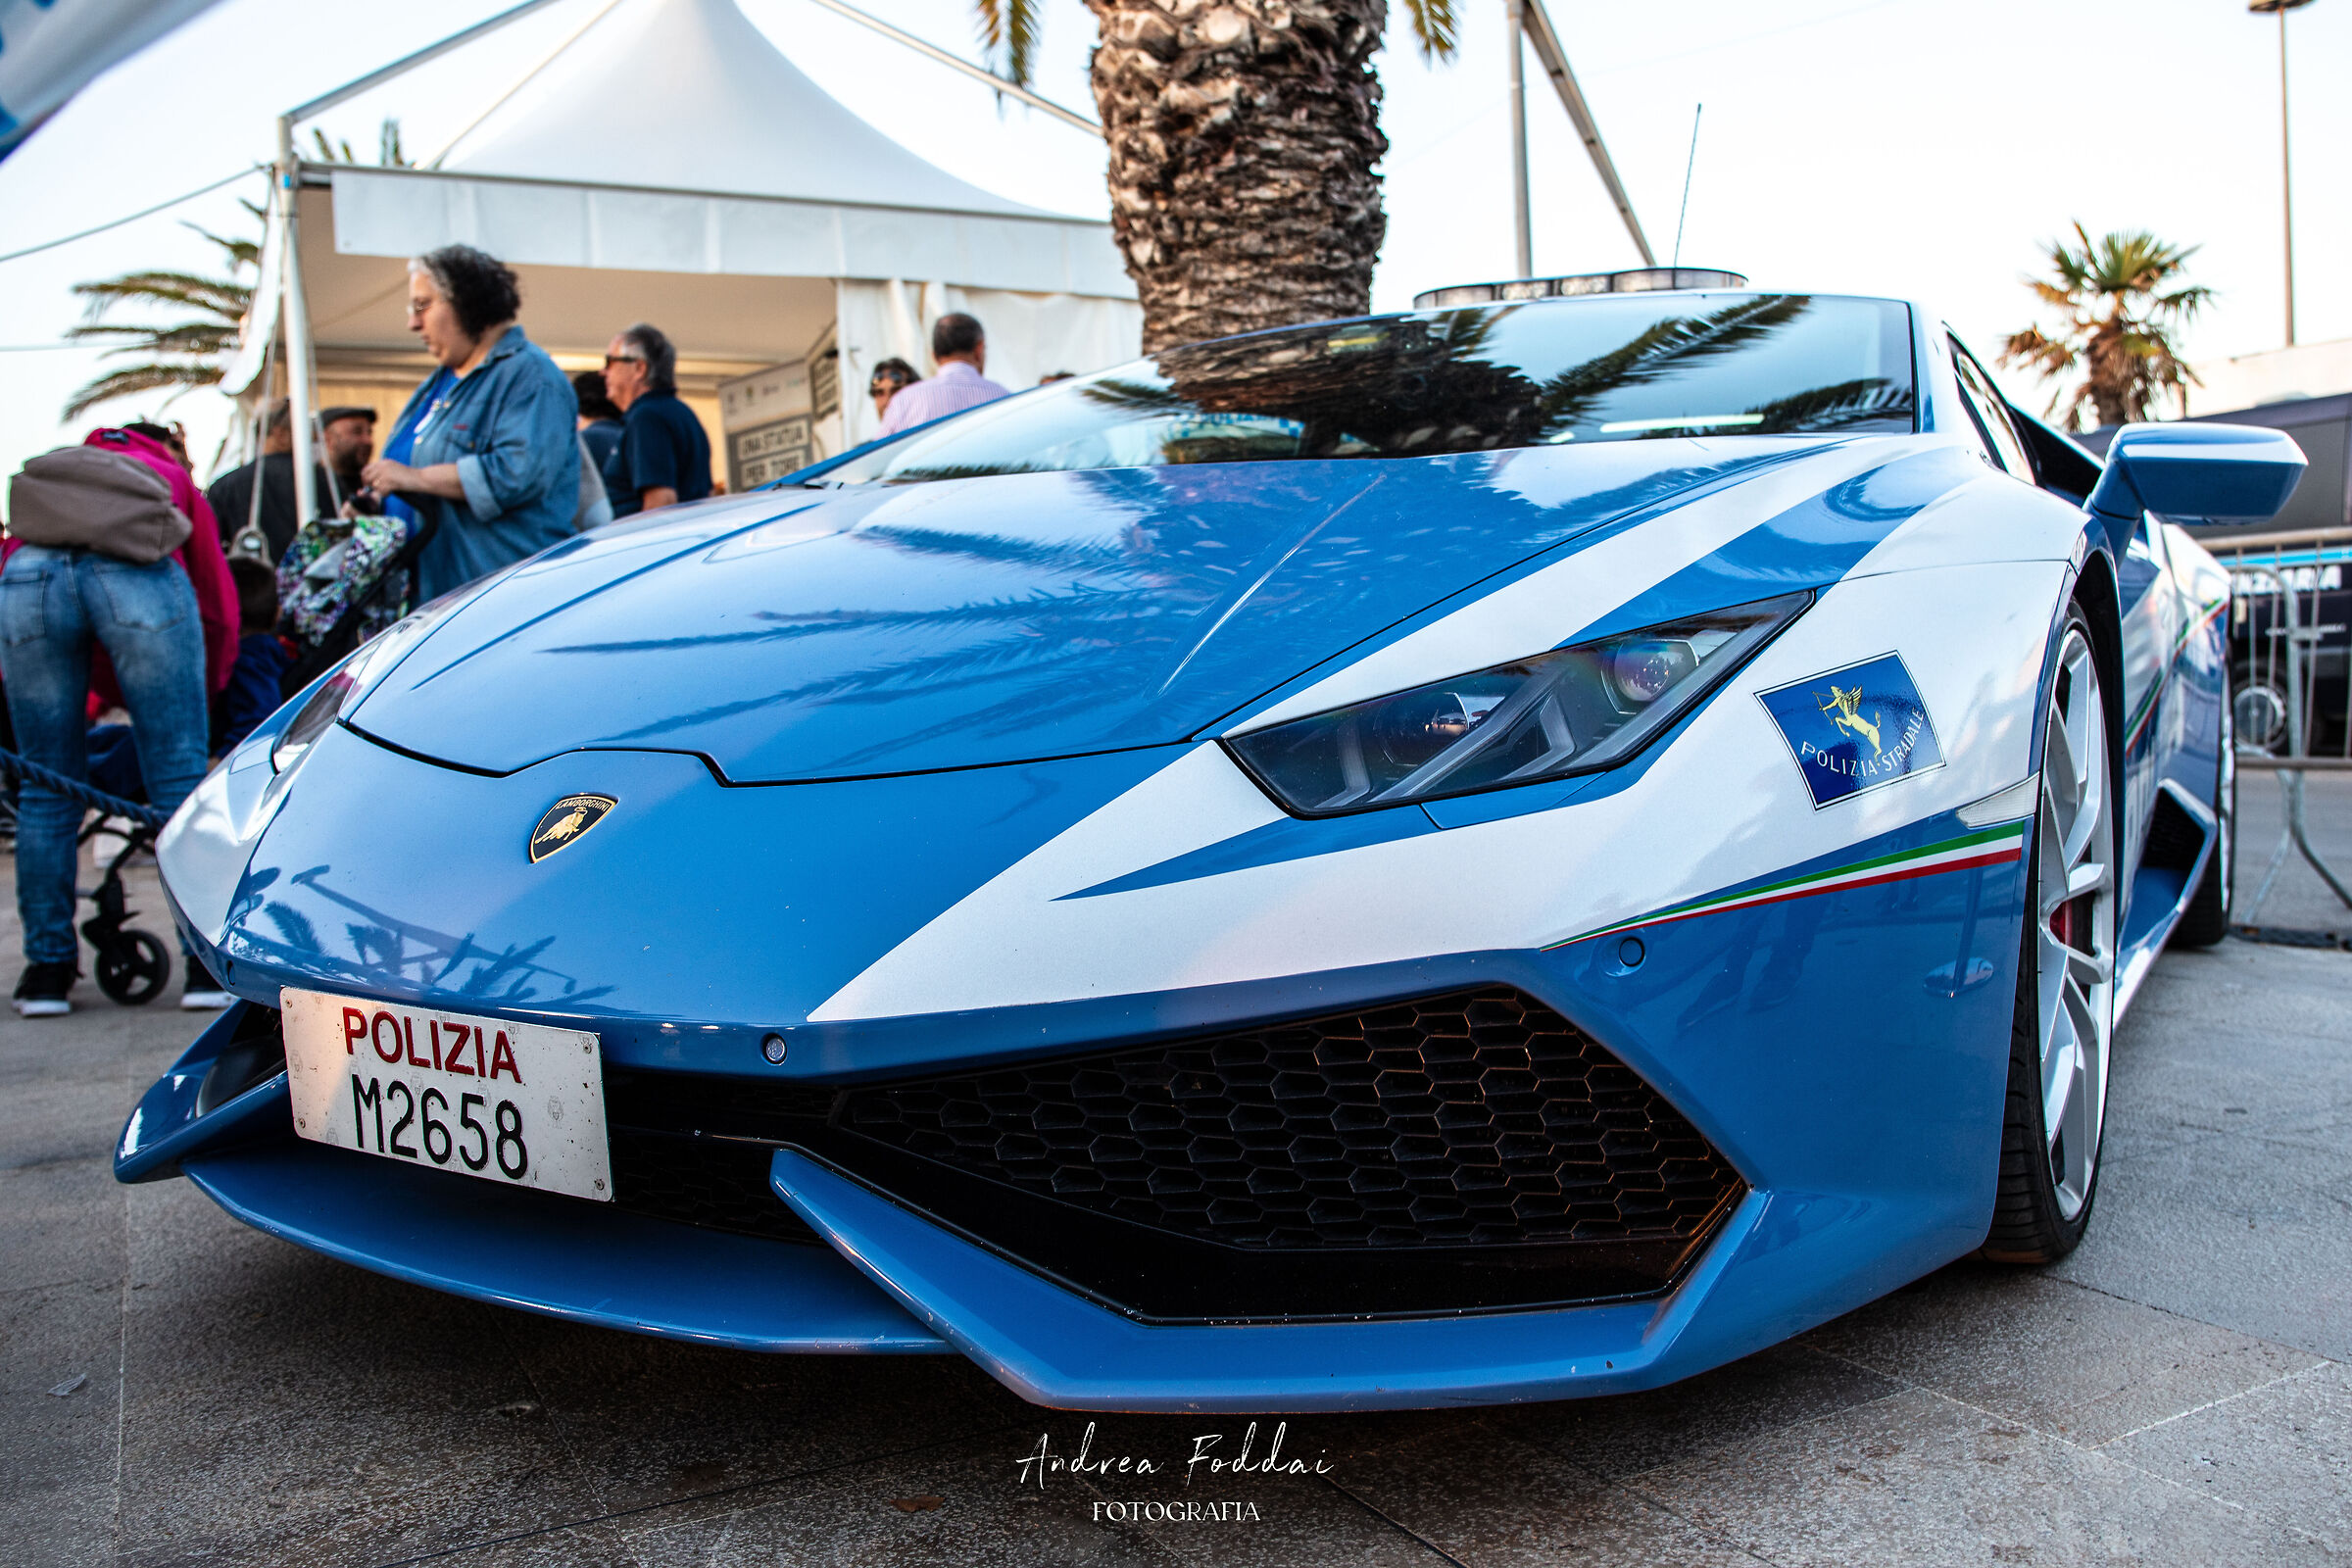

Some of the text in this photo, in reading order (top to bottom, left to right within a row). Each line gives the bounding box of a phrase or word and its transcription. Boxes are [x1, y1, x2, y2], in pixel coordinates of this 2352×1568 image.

[1800, 708, 1925, 777] POLIZIA STRADALE
[556, 799, 611, 812] LAMBORGHINI
[342, 1005, 522, 1084] POLIZIA
[351, 1073, 529, 1180] M2658
